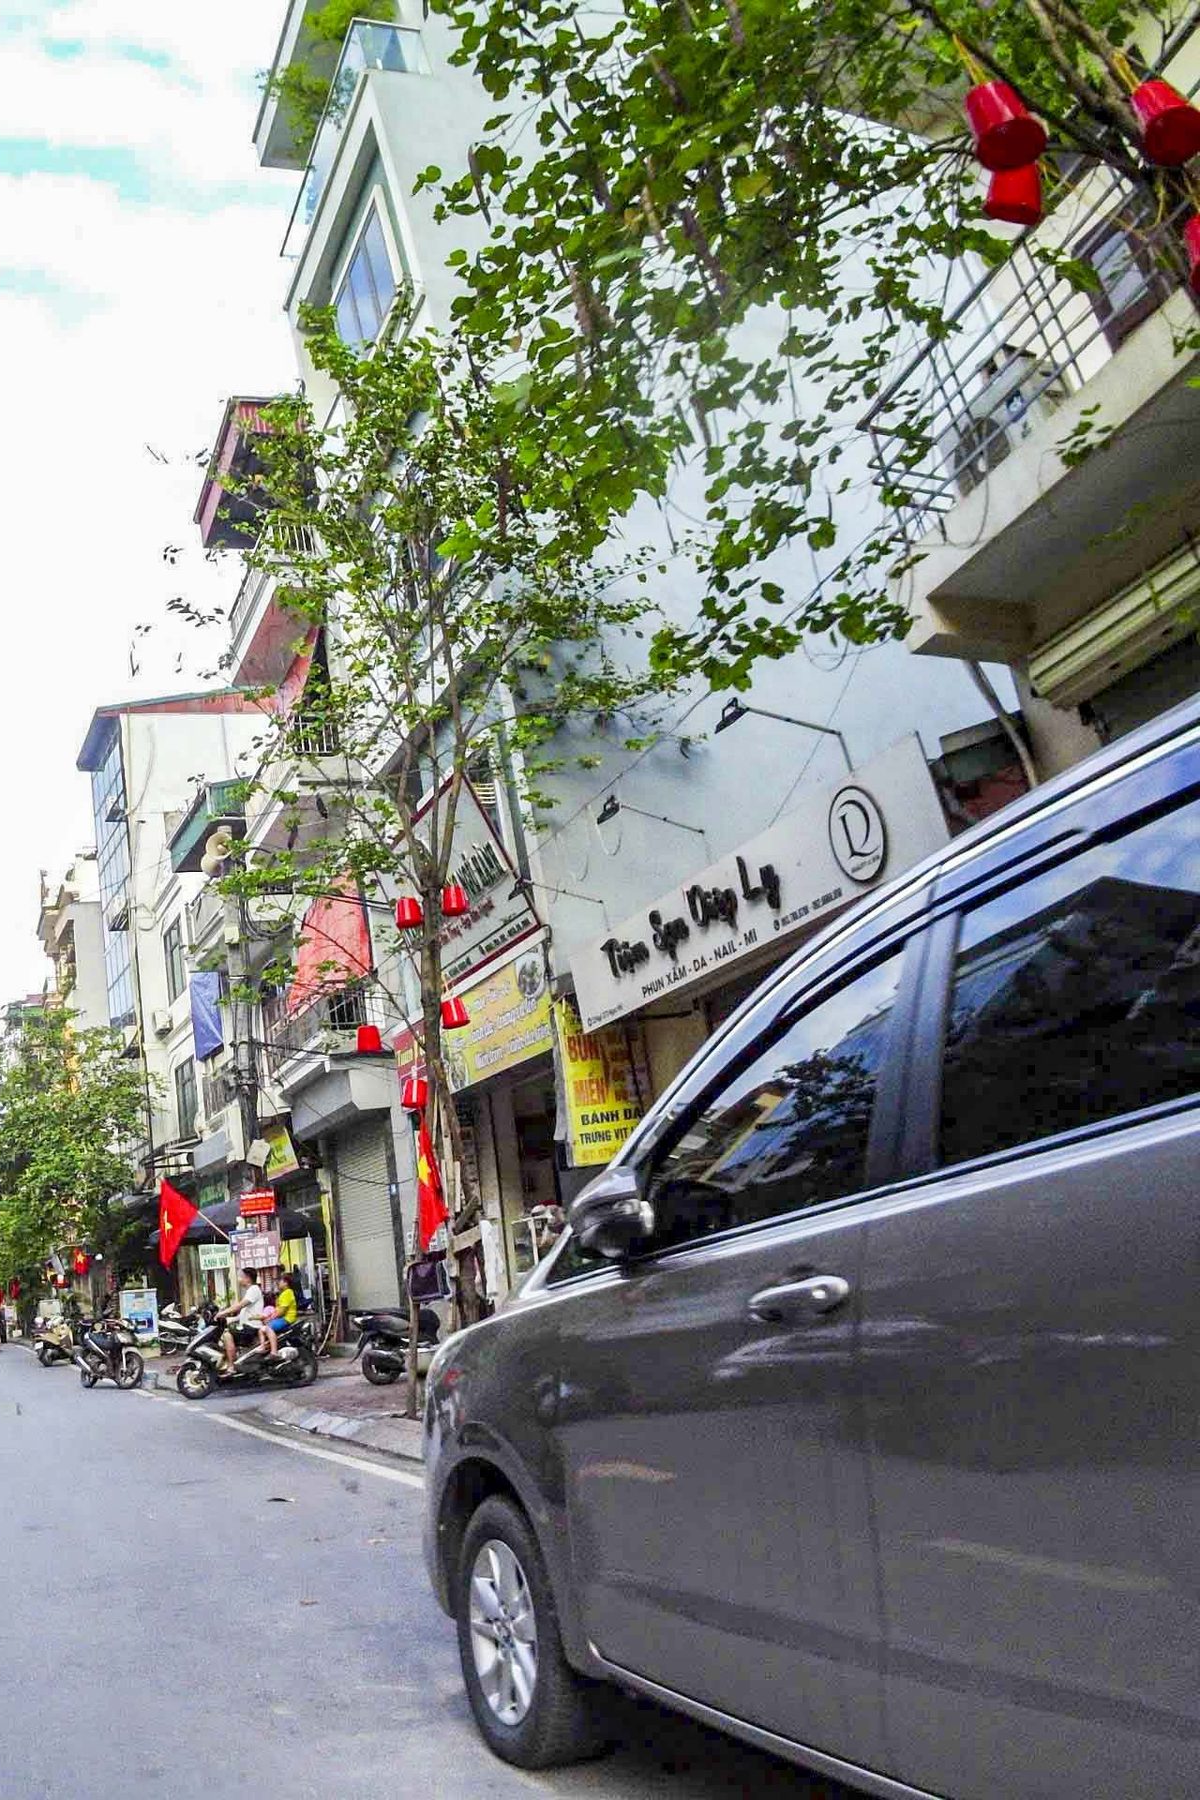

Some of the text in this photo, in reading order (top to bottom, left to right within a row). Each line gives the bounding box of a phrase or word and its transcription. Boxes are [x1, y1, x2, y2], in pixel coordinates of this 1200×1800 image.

[641, 978, 665, 998] PHUN
[693, 955, 708, 972] DA
[714, 940, 737, 960] NAIL
